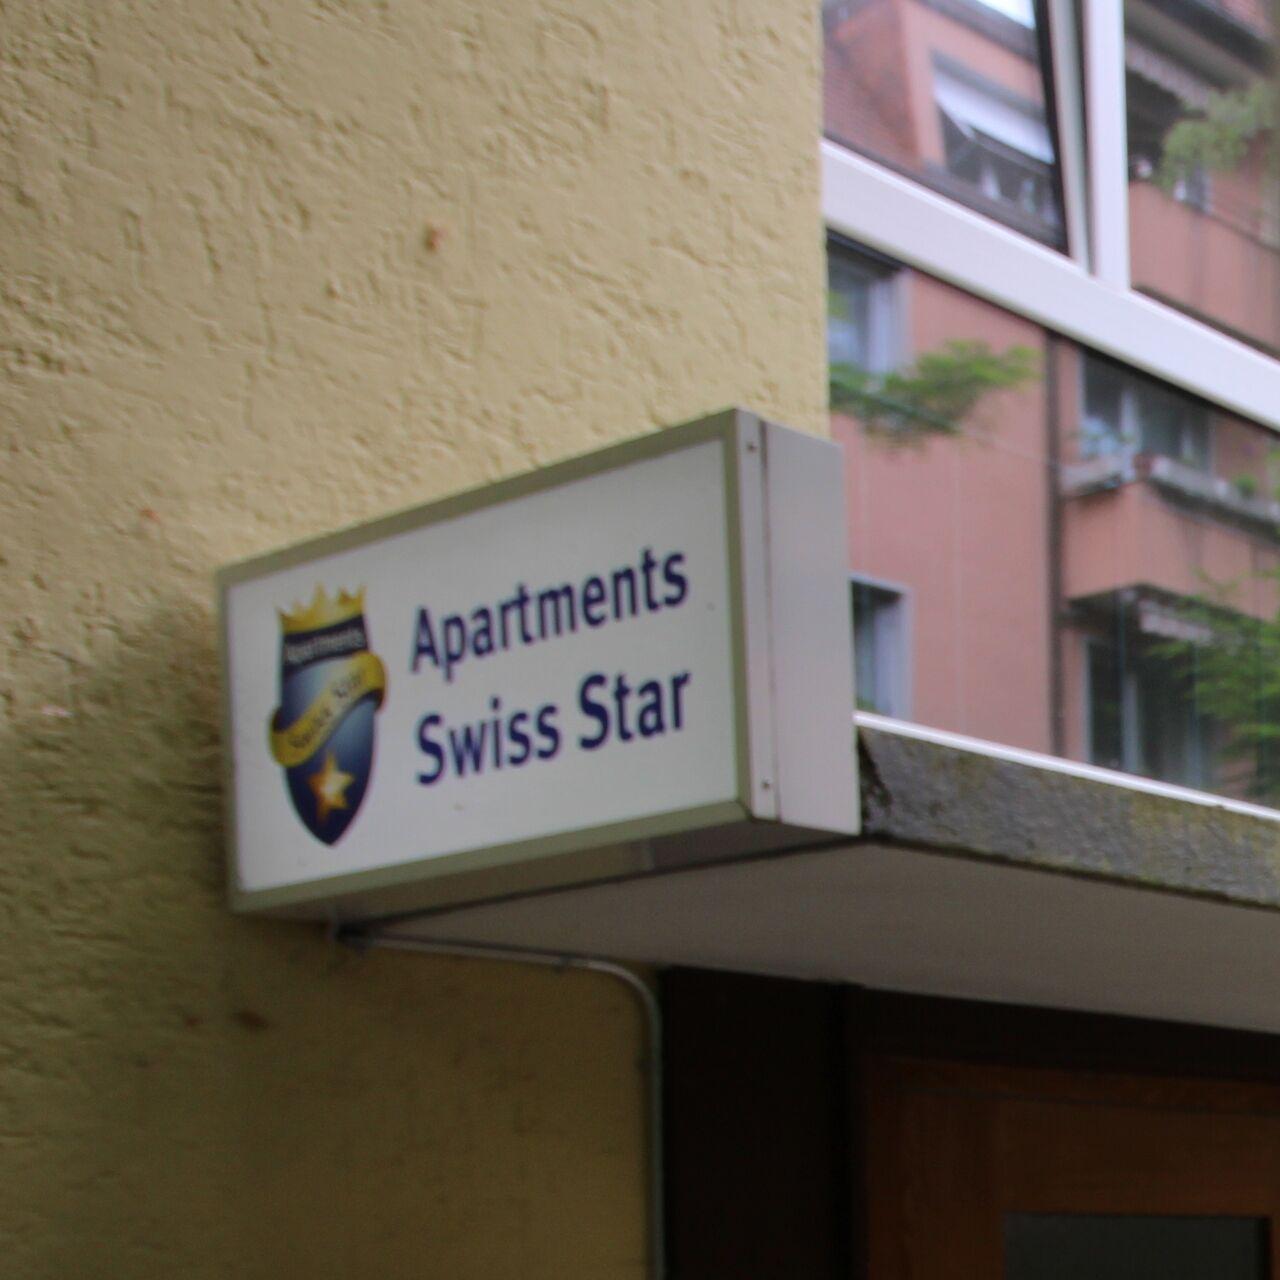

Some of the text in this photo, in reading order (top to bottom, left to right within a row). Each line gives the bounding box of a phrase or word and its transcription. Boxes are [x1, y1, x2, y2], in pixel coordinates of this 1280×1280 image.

[411, 548, 688, 682] Apartments
[416, 697, 560, 784] Swiss
[579, 671, 690, 749] Star
